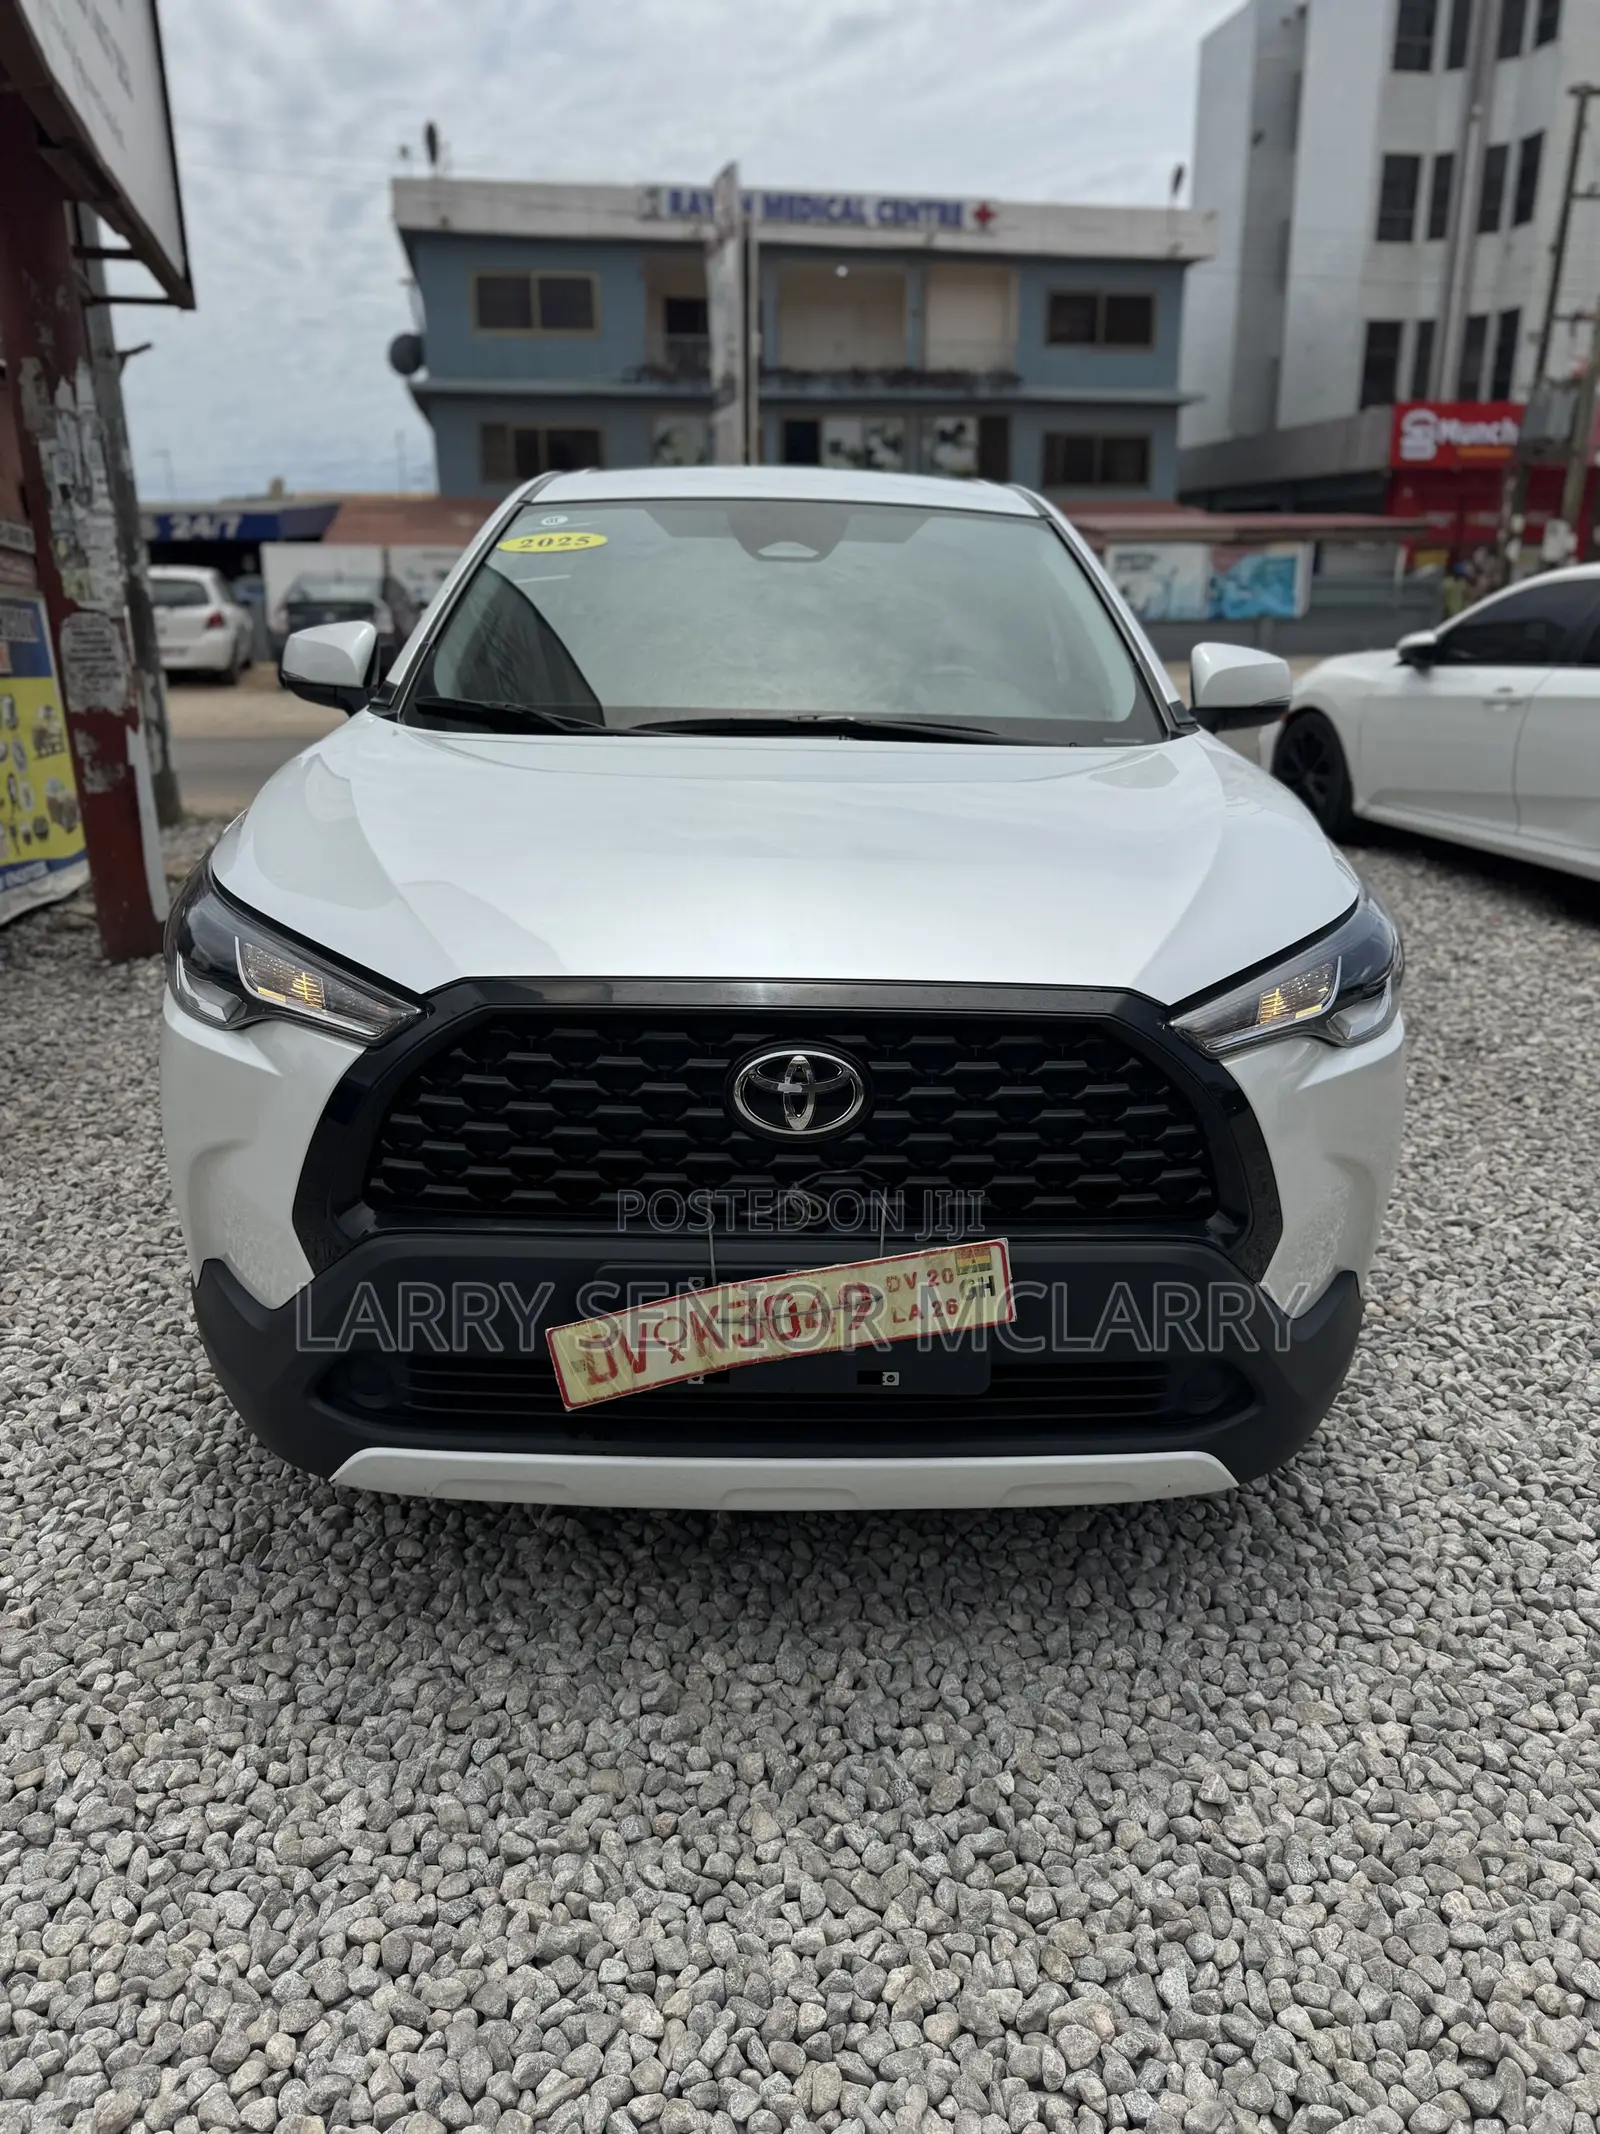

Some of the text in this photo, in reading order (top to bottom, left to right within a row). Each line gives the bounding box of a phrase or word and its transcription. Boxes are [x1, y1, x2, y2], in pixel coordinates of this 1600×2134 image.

[668, 189, 965, 229] RAYN MEDICAL CENTRE
[170, 513, 243, 541] 24/7
[519, 536, 590, 549] 2025
[887, 1267, 954, 1293] DV 20
[959, 1275, 996, 1301] GH
[891, 1298, 959, 1324] LA 26
[586, 1322, 648, 1387] DV
